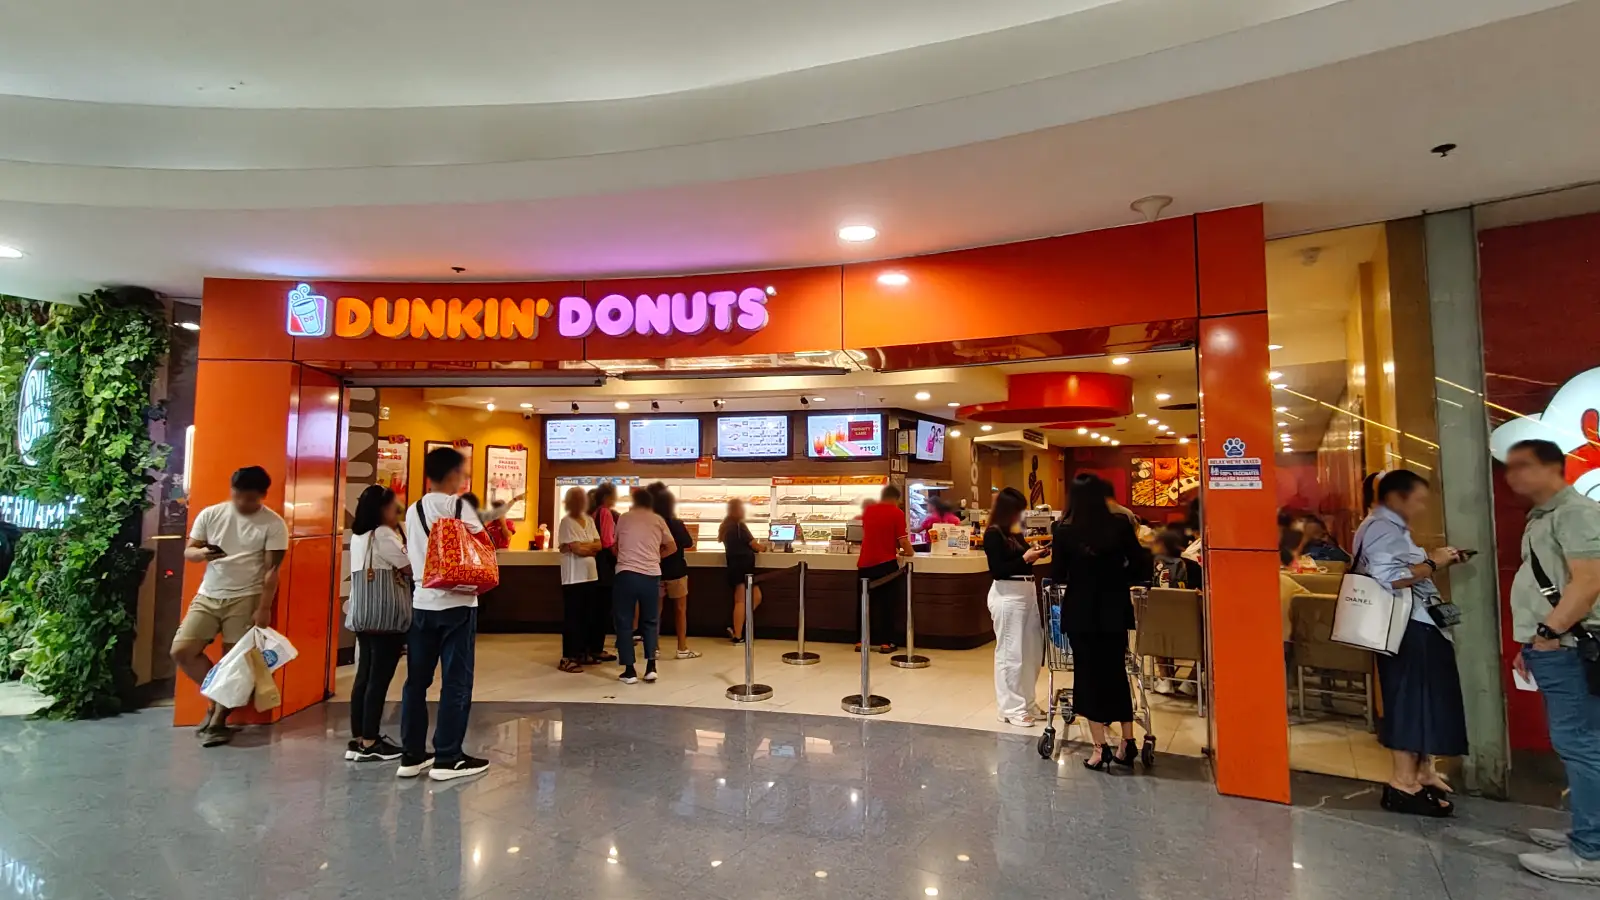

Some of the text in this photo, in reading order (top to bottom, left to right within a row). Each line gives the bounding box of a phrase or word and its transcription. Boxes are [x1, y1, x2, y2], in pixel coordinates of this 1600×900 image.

[335, 287, 769, 340] DUNKIN' DONUTS
[1345, 596, 1373, 605] CHANEL
